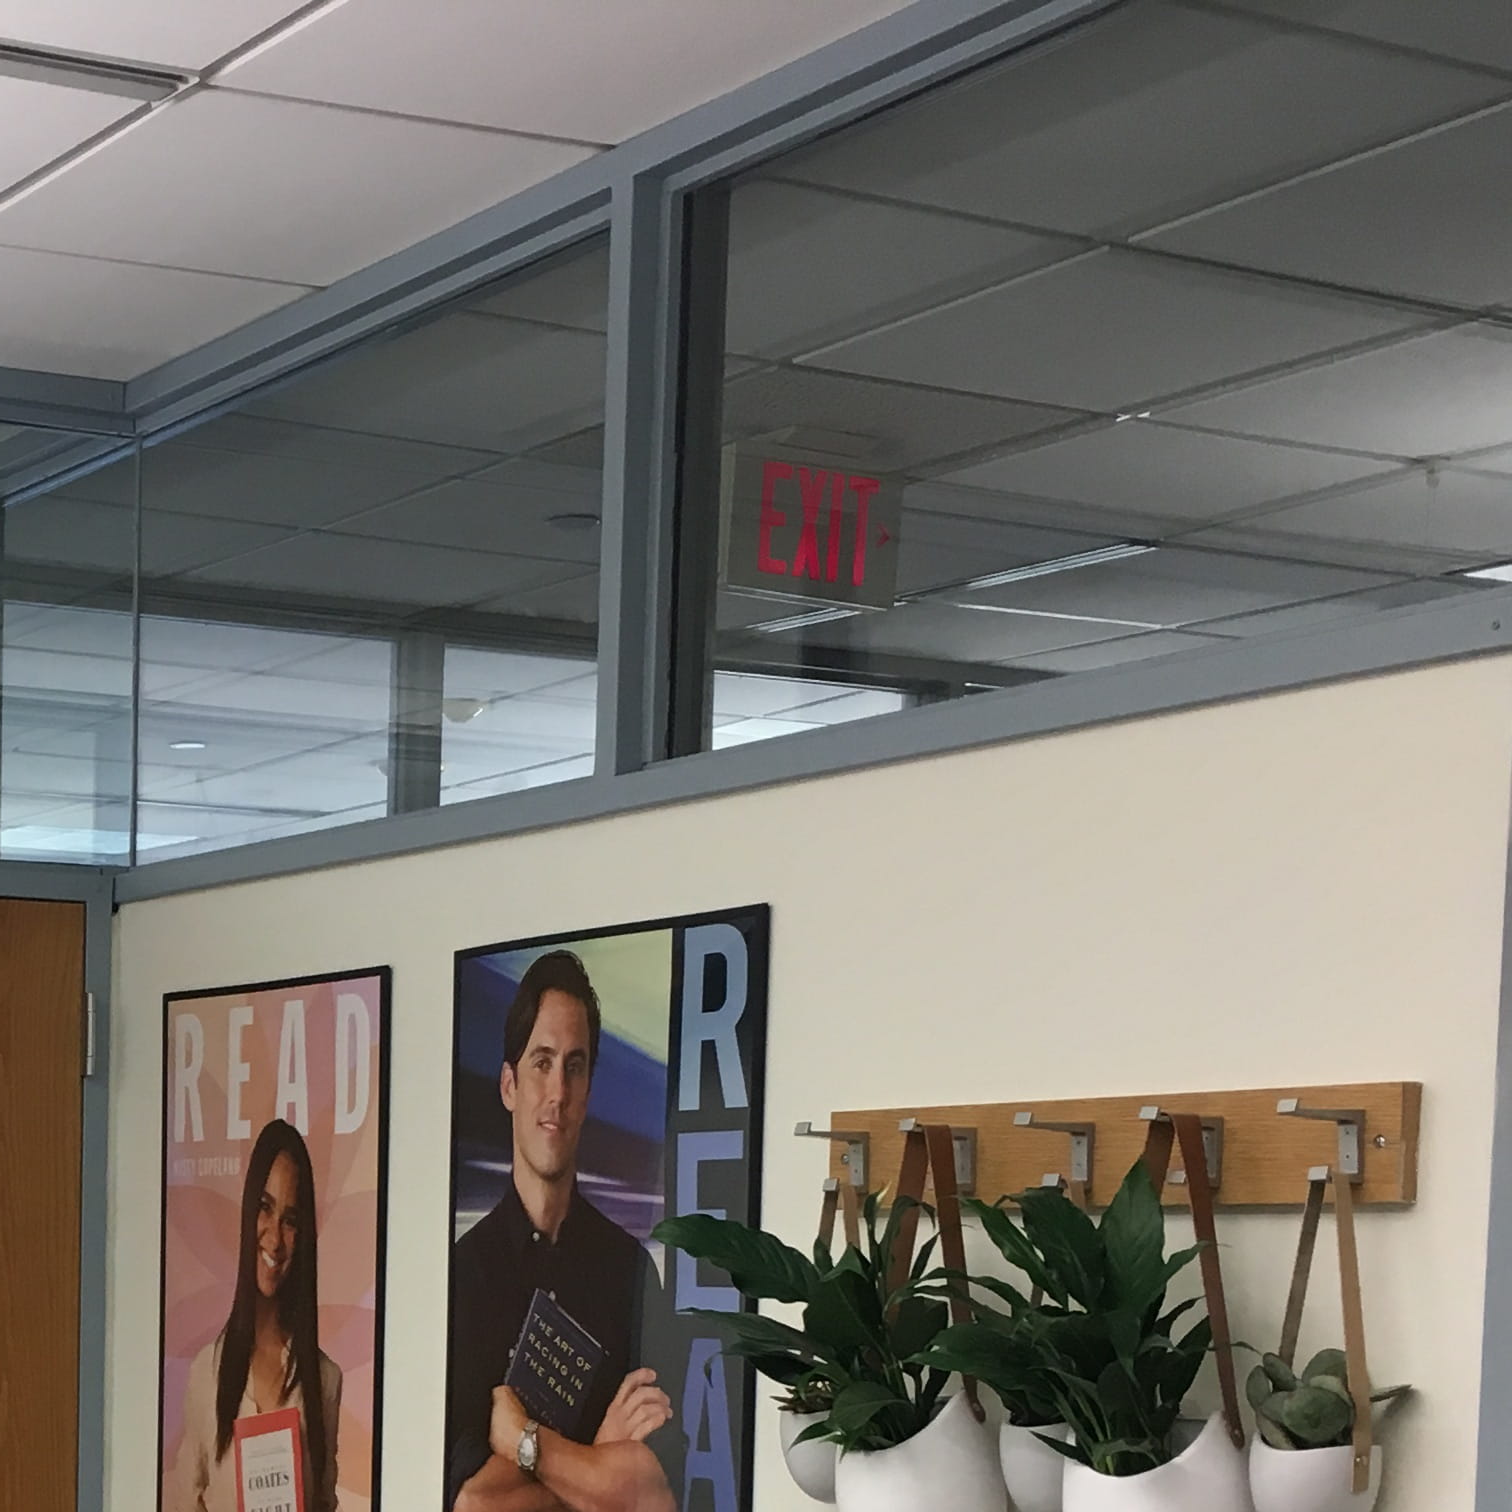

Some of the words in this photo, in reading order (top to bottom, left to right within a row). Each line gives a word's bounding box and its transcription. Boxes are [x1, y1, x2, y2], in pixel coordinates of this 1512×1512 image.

[757, 461, 880, 587] EXIT
[174, 993, 370, 1143] READ
[528, 1333, 568, 1376] RACING
[570, 1375, 584, 1391] IN
[533, 1312, 553, 1336] THE
[553, 1336, 574, 1356] ART
[576, 1356, 591, 1373] OF
[524, 1351, 545, 1377] THE
[547, 1376, 575, 1407] RAIN
